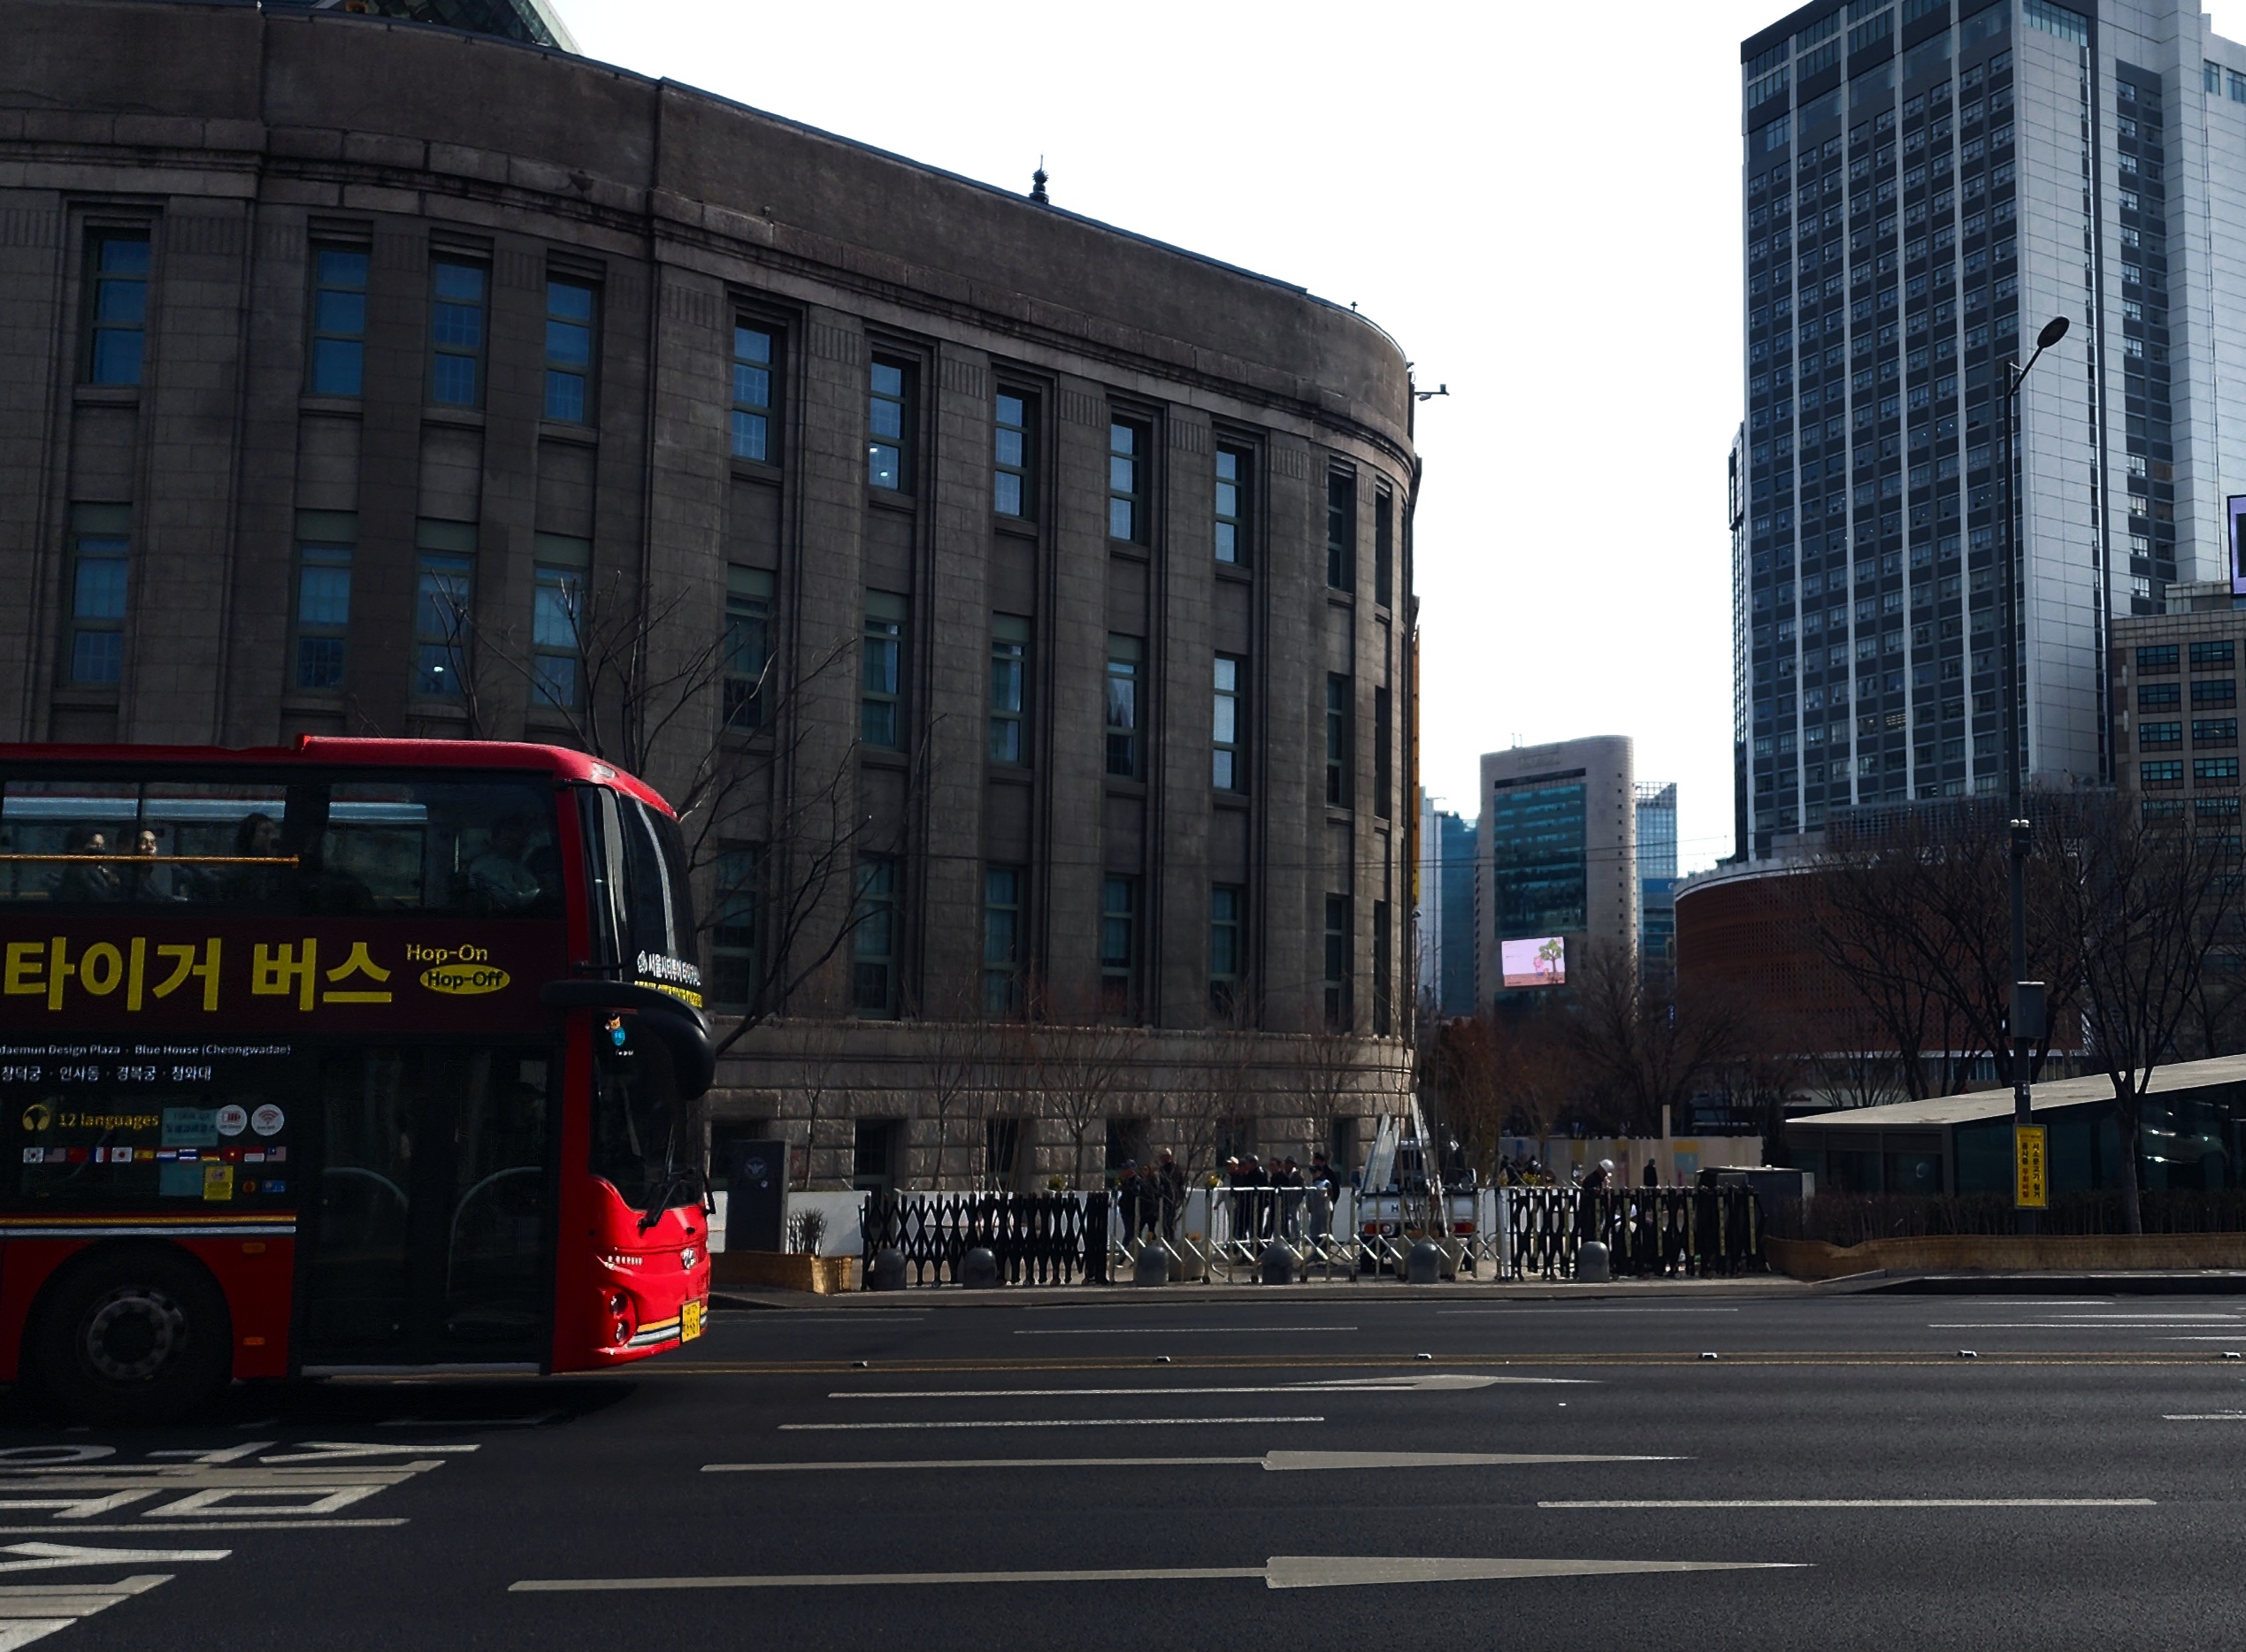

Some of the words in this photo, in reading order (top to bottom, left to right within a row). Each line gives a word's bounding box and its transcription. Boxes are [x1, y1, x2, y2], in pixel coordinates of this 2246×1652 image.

[406, 942, 488, 965] Hop-On
[4, 936, 222, 1012] 타이거
[250, 937, 393, 1012] 버스
[426, 970, 504, 990] Hop-Off
[49, 1044, 87, 1057] Design
[90, 1044, 120, 1055] Plaza
[134, 1044, 160, 1055] Blue
[163, 1044, 199, 1055] House
[202, 1044, 292, 1057] (Cheongwadae)
[1, 1065, 42, 1082] 창덕궁
[59, 1065, 100, 1082] 인사동
[117, 1065, 157, 1082] 경복궁
[172, 1065, 212, 1082] 청와대
[58, 1113, 76, 1127] 12
[80, 1112, 159, 1130] languages
